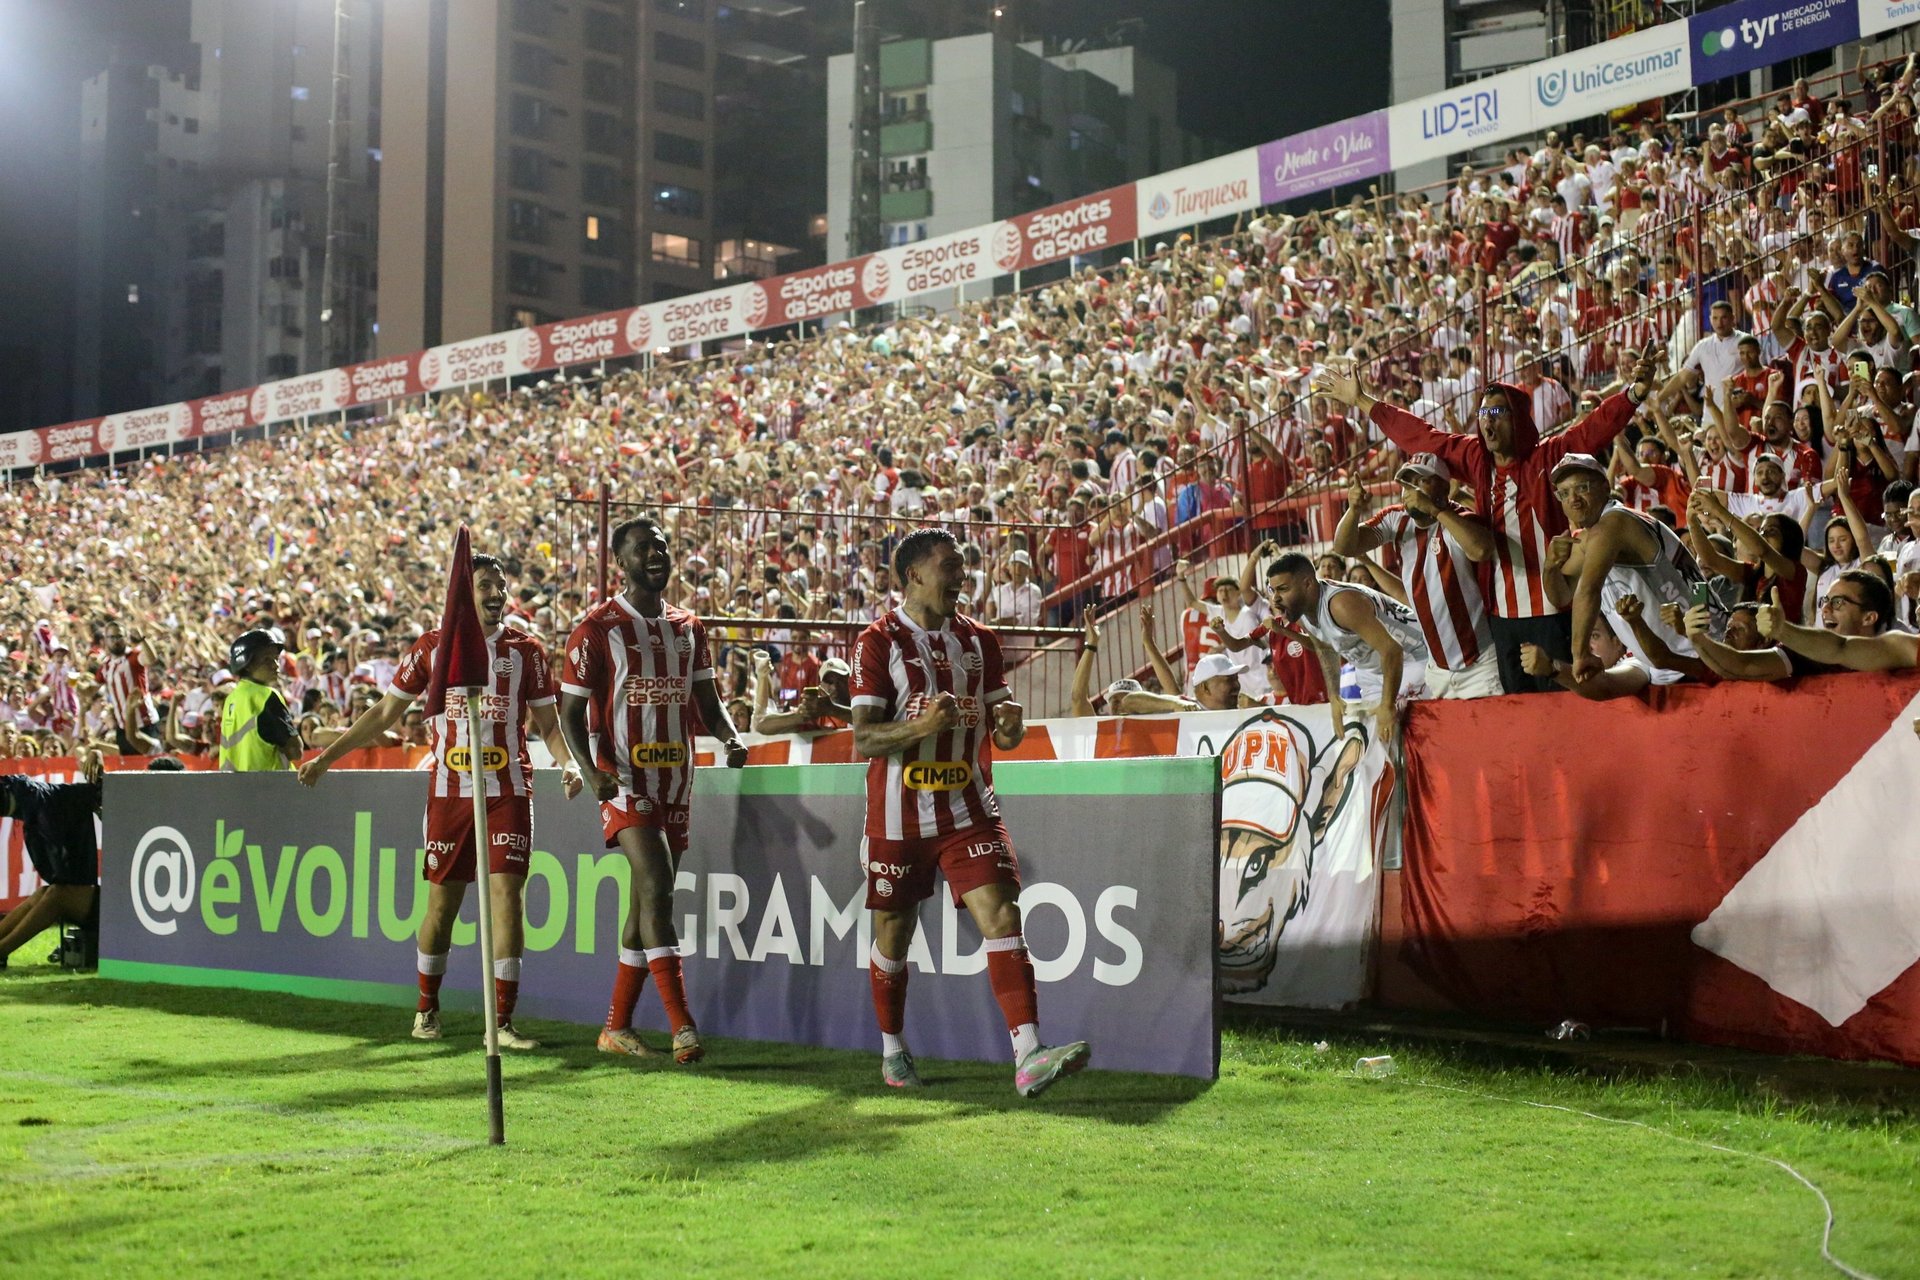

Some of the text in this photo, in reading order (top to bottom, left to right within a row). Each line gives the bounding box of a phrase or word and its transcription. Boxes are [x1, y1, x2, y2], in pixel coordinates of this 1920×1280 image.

[1782, 1, 1824, 21] MERCADO
[1782, 10, 1831, 31] DE ENERGIA
[1885, 4, 1914, 19] Tenha
[1740, 13, 1780, 49] tyr
[1573, 48, 1682, 93] UniCesumar
[1423, 88, 1498, 139] LIDERI
[1322, 146, 1330, 162] e
[1333, 131, 1373, 163] Vida
[1173, 178, 1248, 216] Turquesa
[854, 641, 864, 689] Turquesa
[446, 688, 510, 706] Esprtes
[636, 747, 684, 764] CIMED
[908, 766, 968, 785] CIMED
[436, 841, 456, 854] tyr
[889, 863, 912, 878] tyr
[672, 871, 1144, 987] GRAMADOS
